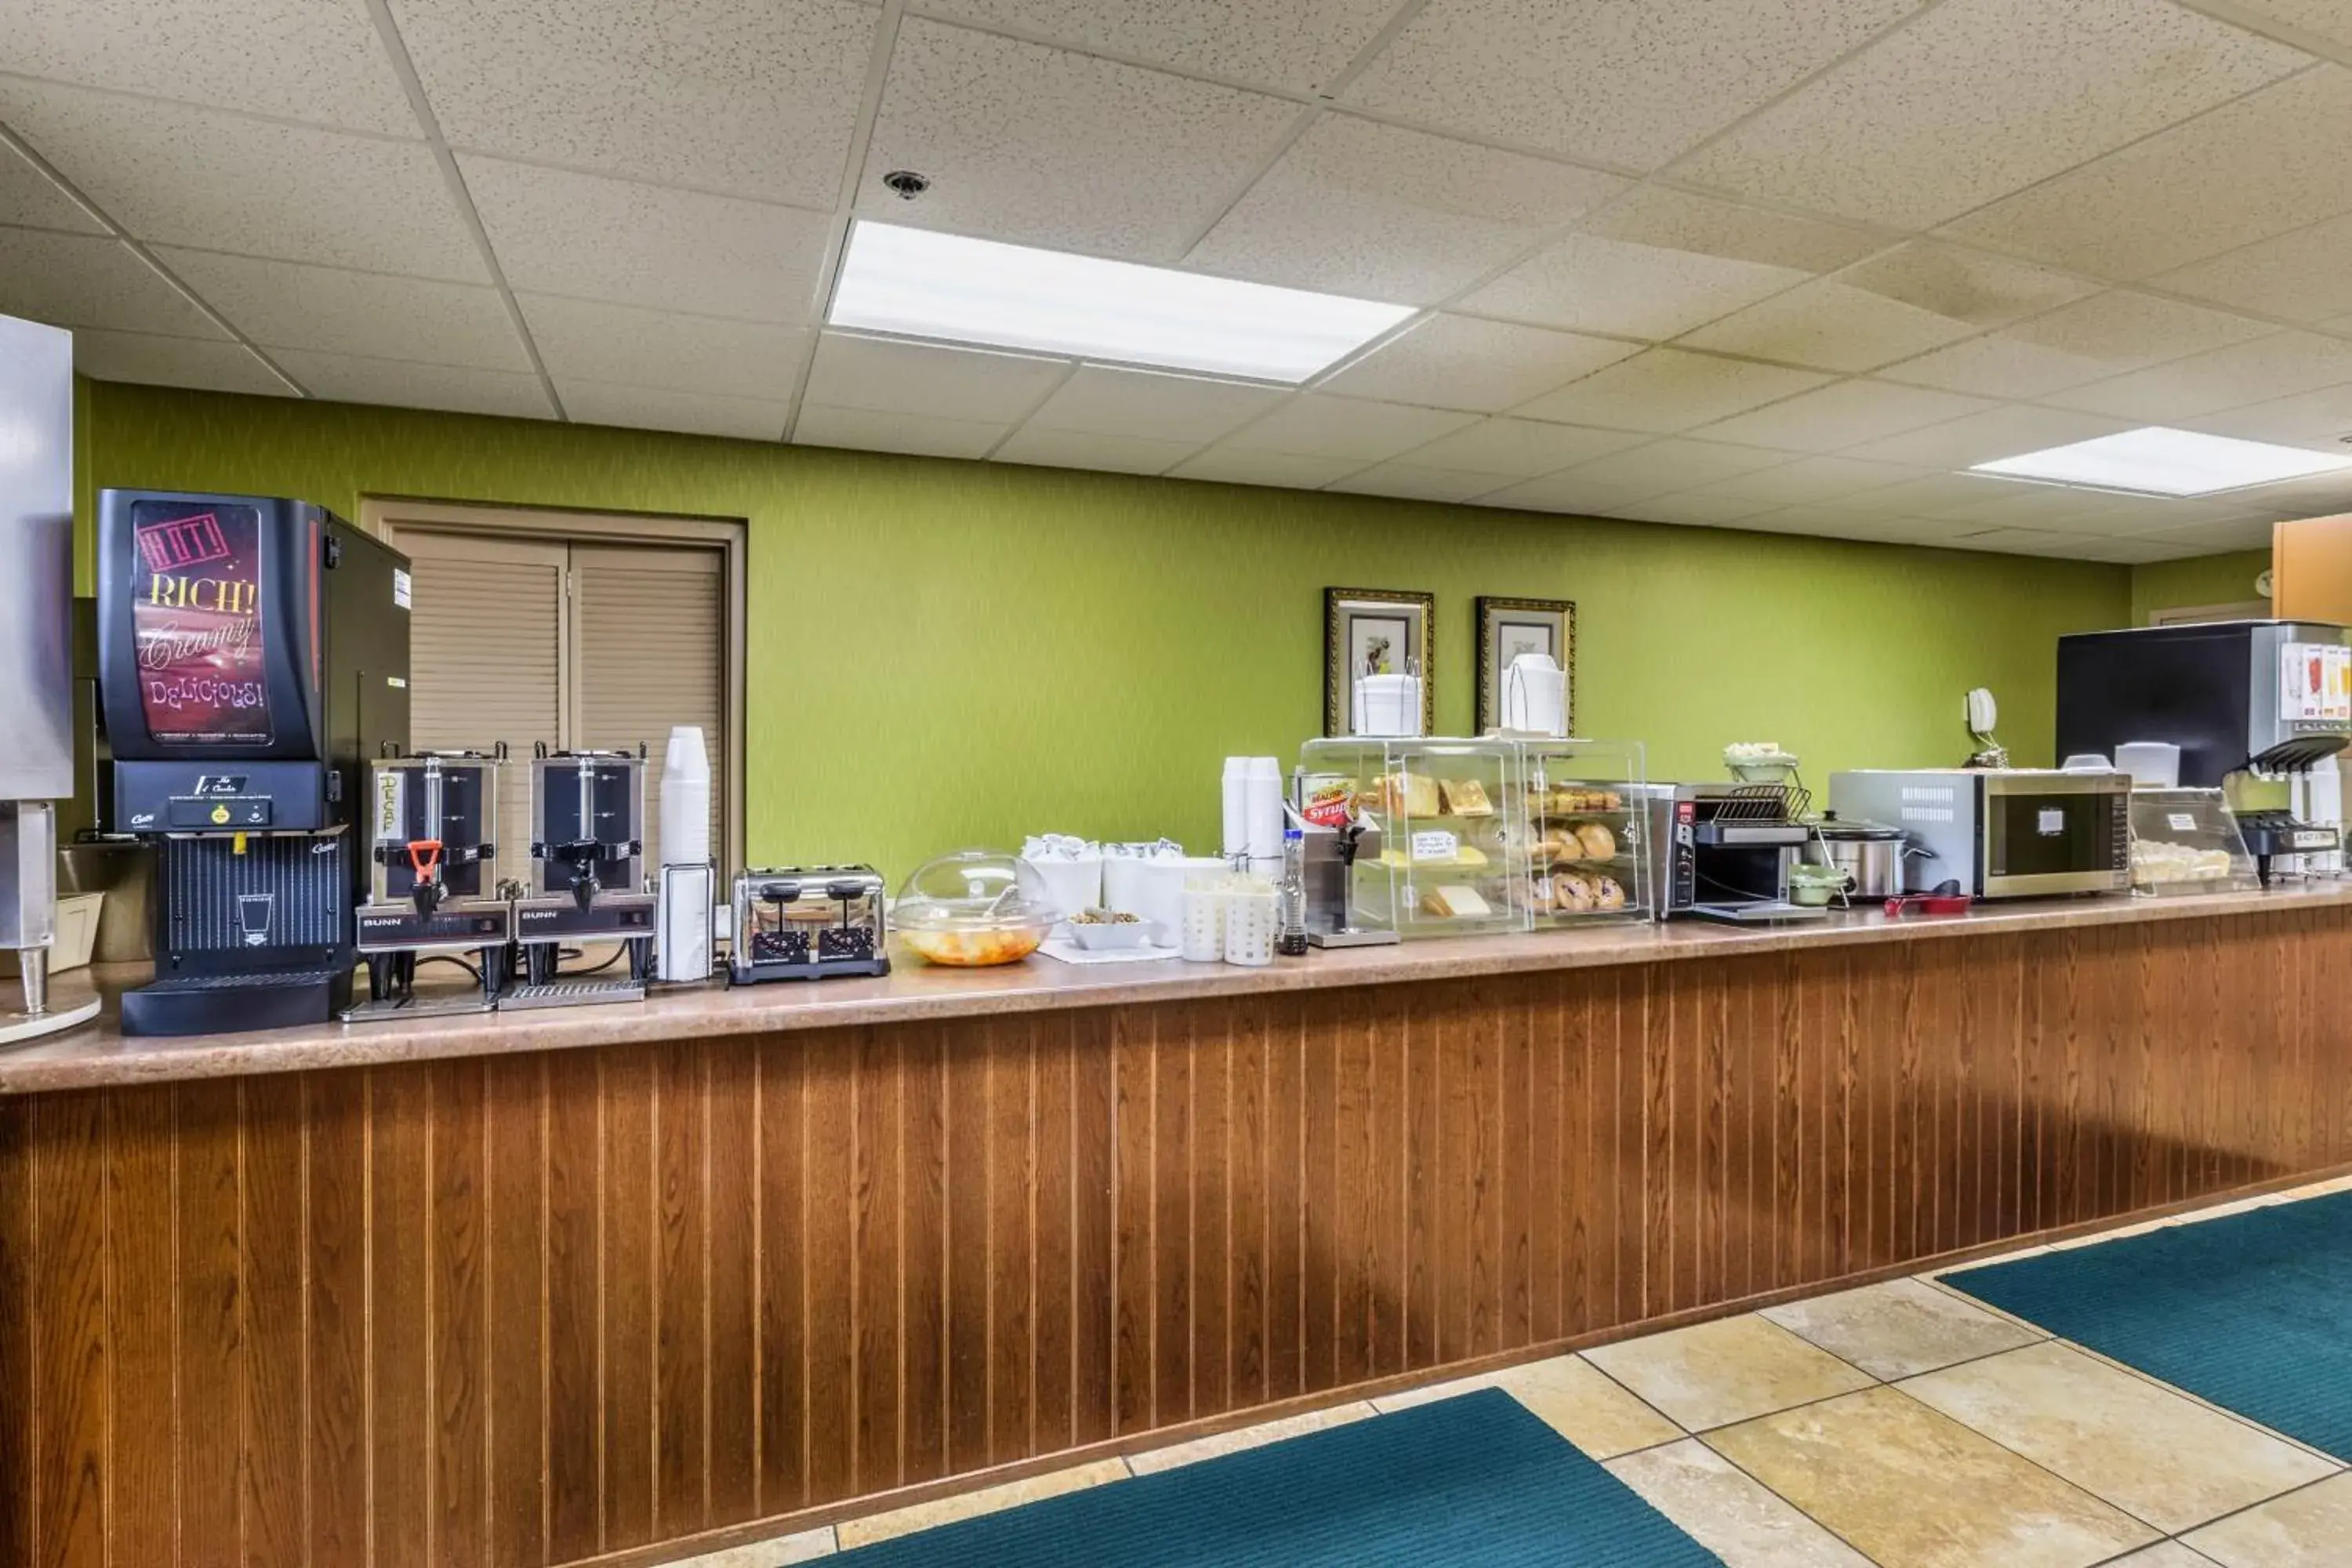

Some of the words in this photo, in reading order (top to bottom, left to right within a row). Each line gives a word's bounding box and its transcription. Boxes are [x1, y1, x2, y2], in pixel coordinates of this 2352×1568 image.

[140, 517, 223, 569] HOT!
[150, 572, 256, 615] RICH!
[139, 619, 255, 670] Creamy
[363, 918, 401, 927] BUNN
[522, 911, 557, 920] BUNN
